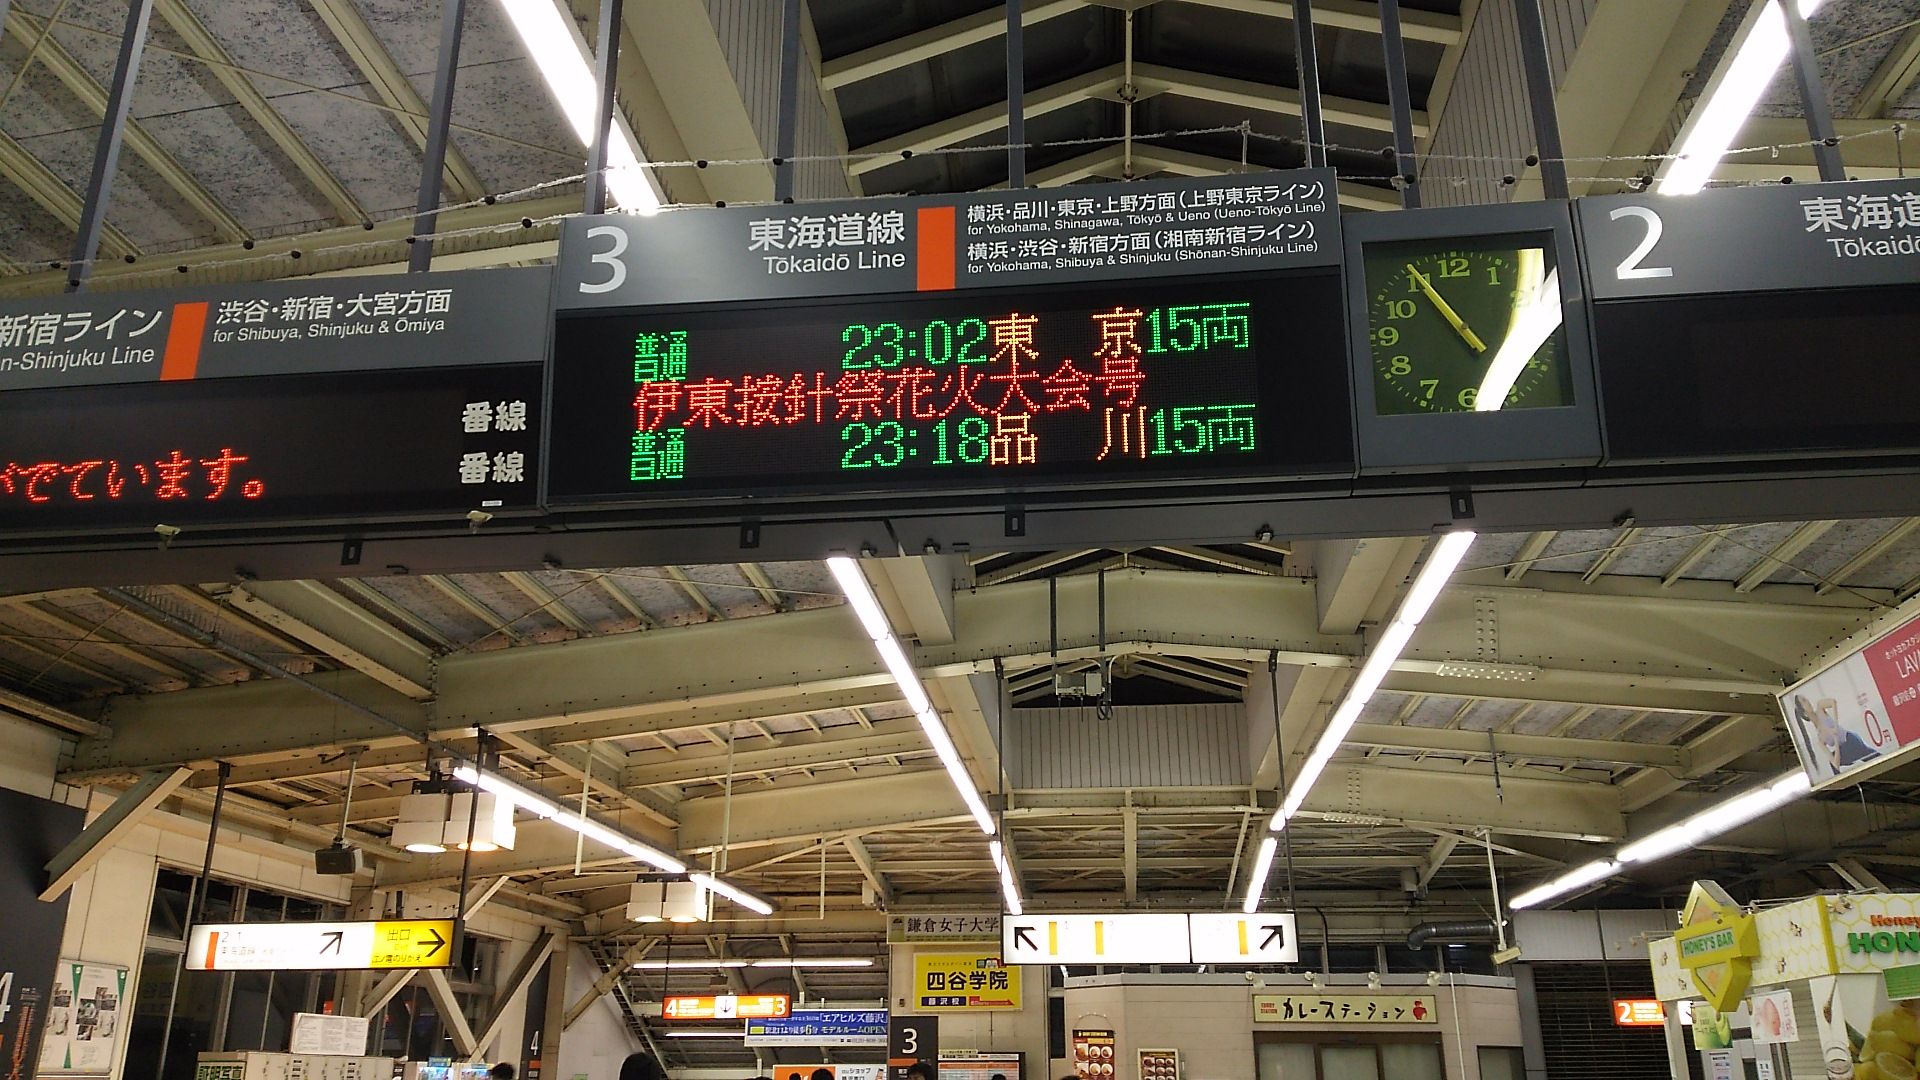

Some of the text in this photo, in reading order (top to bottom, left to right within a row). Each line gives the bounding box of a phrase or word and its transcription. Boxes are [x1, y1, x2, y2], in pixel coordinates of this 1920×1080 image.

[968, 201, 1326, 235] for Yokohama, Shinagawa, Tōkyō & Ueno (Ueno-Tōkyō Line)
[748, 210, 905, 251] 東海道線
[1609, 206, 1673, 280] 2
[579, 225, 629, 294] 3
[763, 251, 905, 274] Tōkaidō Line
[968, 241, 1318, 273] for Yokohama, Shibuya & Shinjuku (Shōnan-Shinjuku Line)
[1437, 258, 1470, 278] 12
[1487, 267, 1500, 286] 1
[1385, 300, 1416, 320] 10
[0, 309, 162, 347] 新宿ライン
[213, 316, 445, 342] for Shibuya, Shinjuku & Ōmiya
[1378, 327, 1399, 346] 9
[634, 330, 687, 382] 普通
[842, 318, 987, 369] 23:02
[1146, 303, 1250, 353] 15両
[112, 345, 155, 364] Line
[1391, 356, 1411, 375] 8
[1420, 380, 1439, 399] 7
[1458, 388, 1478, 408] 6
[462, 400, 526, 432] 番線
[631, 428, 684, 480] 普通
[842, 417, 989, 468] 23:18
[1150, 404, 1255, 454] 15両
[459, 451, 524, 483] 番線
[387, 929, 411, 941] 出口
[907, 917, 999, 933] 鎌倉女子大学
[1683, 930, 1734, 954] HONEY'S BAR
[927, 971, 1009, 990] 四谷学院
[665, 999, 677, 1017] 4
[775, 998, 786, 1016] 3
[1283, 998, 1405, 1020] カレーステーション
[1618, 1002, 1633, 1023] 2
[530, 1031, 539, 1056] 4
[902, 1028, 917, 1054] 3
